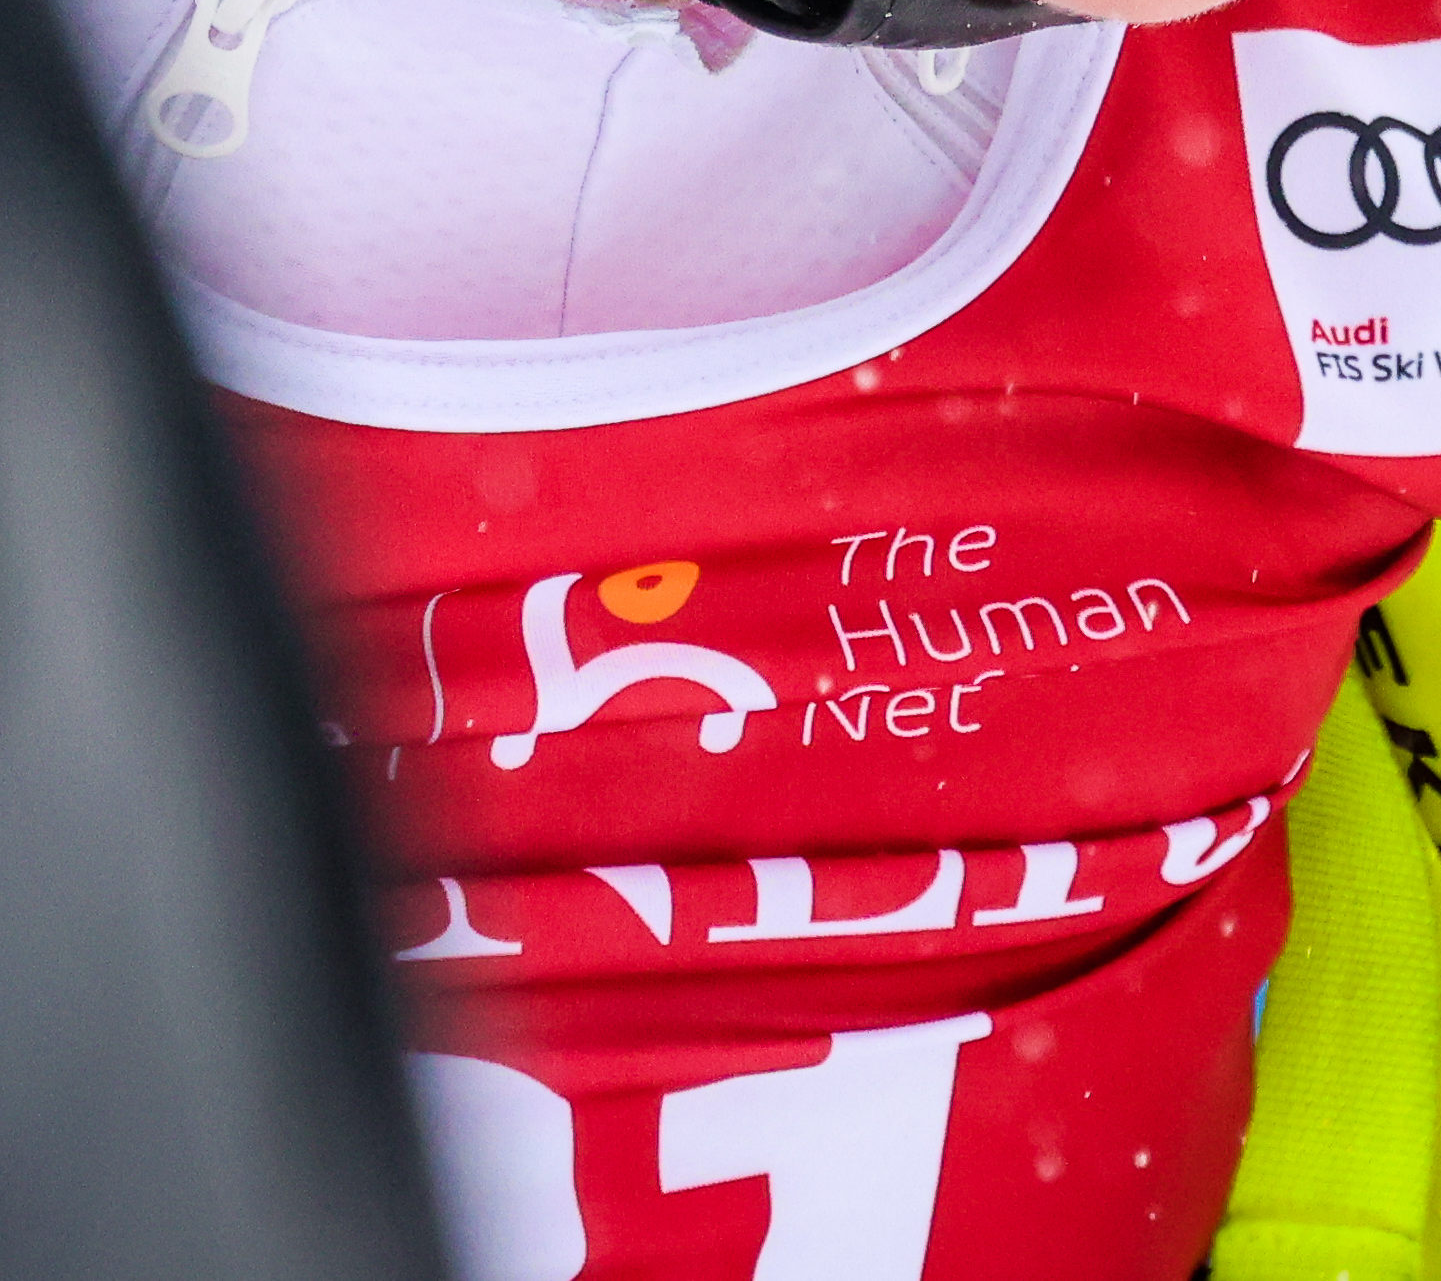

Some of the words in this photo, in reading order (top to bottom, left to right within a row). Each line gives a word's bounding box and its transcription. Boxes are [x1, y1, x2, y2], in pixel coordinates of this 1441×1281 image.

[1311, 316, 1390, 346] Audi
[1316, 351, 1364, 382] FIS
[1371, 351, 1424, 382] Ski
[831, 524, 997, 586] The
[827, 578, 1192, 672] Human
